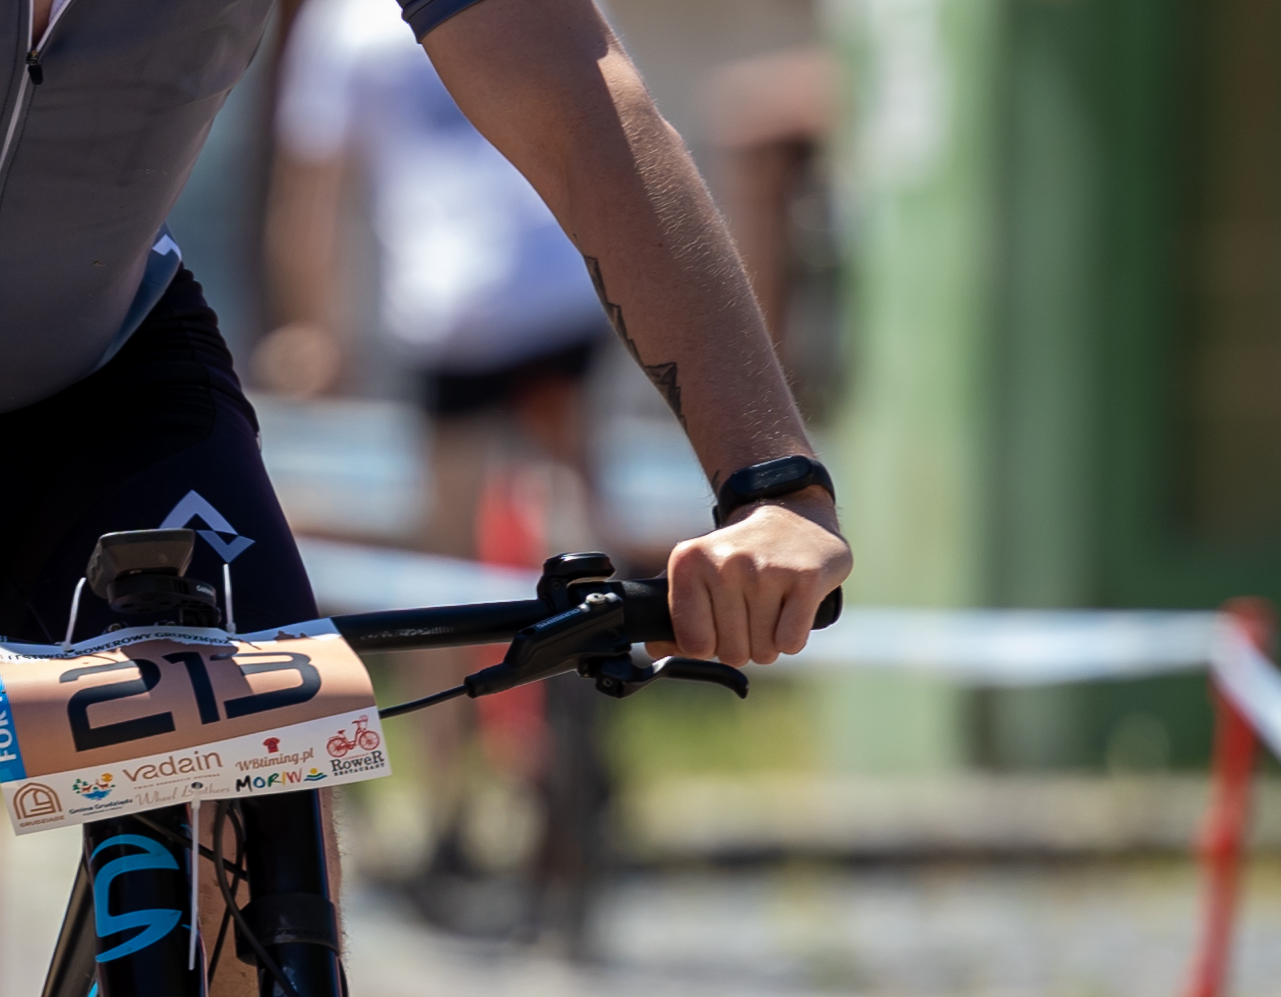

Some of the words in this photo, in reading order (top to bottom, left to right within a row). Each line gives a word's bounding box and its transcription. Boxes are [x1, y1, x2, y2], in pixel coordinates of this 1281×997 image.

[74, 633, 151, 656] ROWEROWY
[59, 652, 322, 752] 213
[122, 750, 223, 782] vadain
